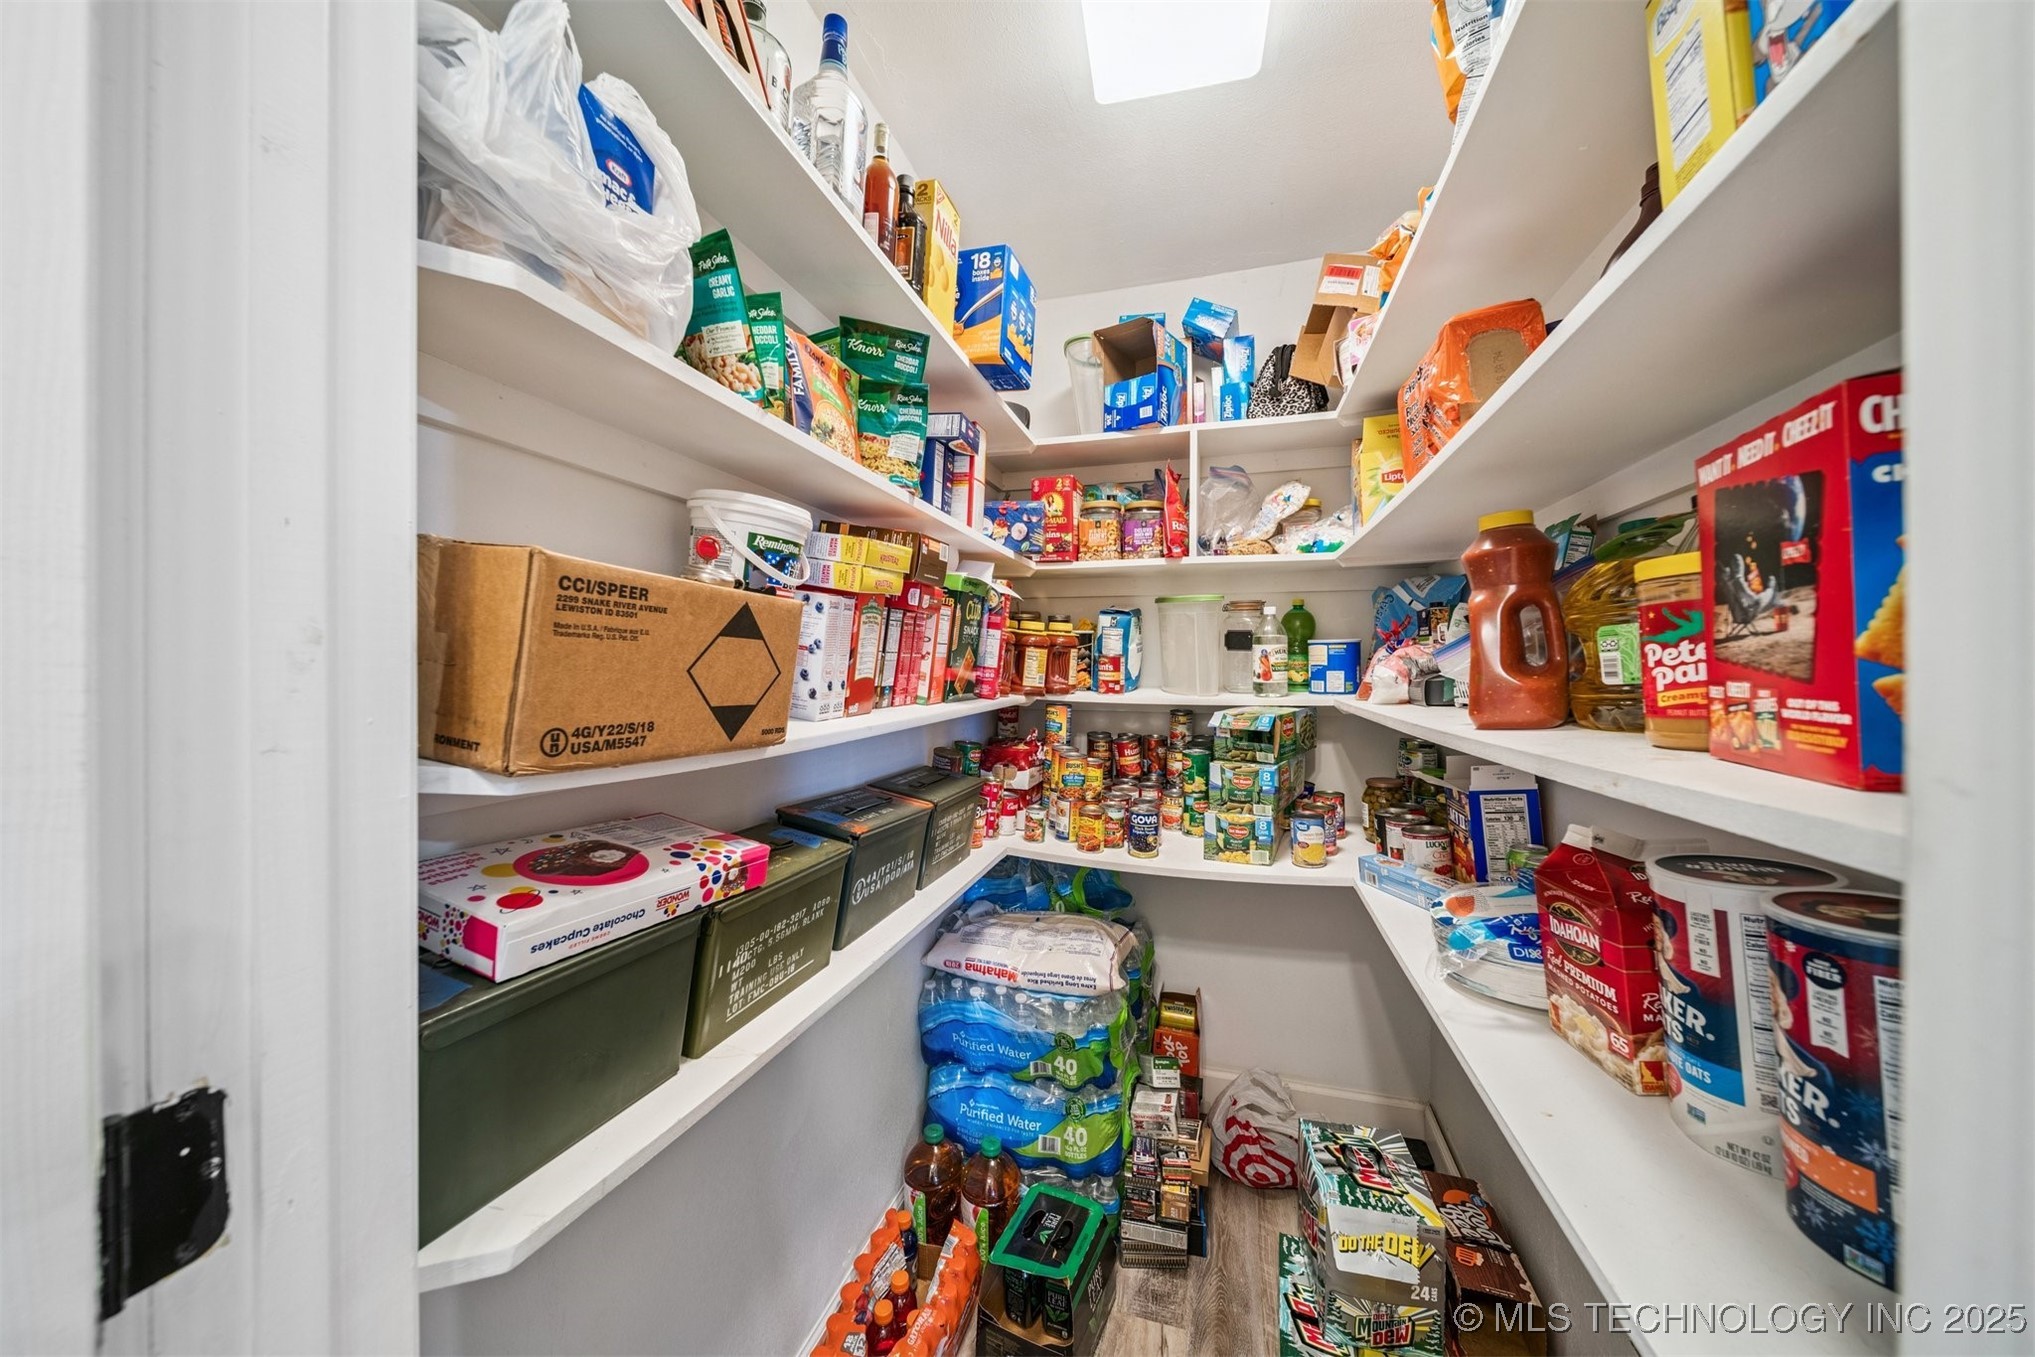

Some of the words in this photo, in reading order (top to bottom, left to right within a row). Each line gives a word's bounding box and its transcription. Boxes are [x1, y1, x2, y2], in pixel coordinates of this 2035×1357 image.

[917, 183, 929, 196] 2
[935, 210, 958, 260] Nilla
[970, 252, 991, 269] 18
[708, 274, 732, 289] CREAMY
[712, 286, 736, 300] GARLIC
[847, 338, 885, 358] Knorr
[894, 361, 918, 375] BROCCOLI
[895, 354, 920, 367] CHEDDAR
[857, 398, 888, 414] Knorr
[899, 407, 923, 416] CHEDDAR
[1158, 385, 1169, 426] Ziploc
[897, 414, 923, 423] BROCCOLI
[753, 535, 800, 555] Remington
[558, 575, 649, 601] CCI/SPEER
[555, 603, 603, 616] LEWISTON
[604, 608, 614, 617] ID
[615, 610, 638, 619] 83501
[556, 594, 579, 604] 2299
[581, 597, 611, 608] SNAKE
[612, 600, 637, 611] RIVER
[638, 604, 669, 615] AVENUE
[552, 629, 591, 639] Trademarks
[553, 621, 572, 630] Made
[963, 626, 979, 636] SNACK
[571, 721, 655, 739] 4G/Y22/S/18
[570, 736, 647, 755] USA/M5547
[1065, 762, 1084, 770] BUSH'S
[1263, 772, 1271, 782] 8
[1131, 814, 1158, 825] GOYA
[1259, 821, 1267, 831] 8
[656, 889, 690, 908] WONDER
[593, 908, 646, 932] Chocolate
[530, 927, 591, 954] Cupcakes
[736, 907, 808, 956] 1305-00-182-3217
[1549, 914, 1601, 952] IDAHOAN
[728, 969, 767, 1005] TRAINING
[770, 959, 785, 975] USE
[786, 946, 805, 966] ONLY
[730, 976, 743, 993] WT
[768, 951, 784, 968] LBS
[732, 958, 757, 982] M200
[964, 961, 1019, 983] Mahatma
[1546, 946, 1563, 968] Real
[1564, 958, 1618, 1003] PREMIUM
[1805, 965, 1843, 984] FIBER
[1039, 978, 1064, 987] Enriched
[1064, 980, 1081, 990] Long
[1082, 982, 1097, 990] Extra
[1548, 964, 1574, 989] MASHED
[1574, 980, 1619, 1015] POTATOES
[952, 1034, 995, 1053] Purified
[997, 1044, 1032, 1060] Water
[1611, 1032, 1630, 1055] 65
[1053, 1056, 1078, 1075] 40
[960, 1102, 1005, 1125] Purified
[1006, 1113, 1042, 1132] Water
[1063, 1126, 1088, 1146] 40
[1065, 1150, 1088, 1160] BOTTLES
[1726, 1141, 1740, 1152] NET
[1752, 1150, 1761, 1161] 42
[1338, 1235, 1357, 1252] DO
[1359, 1233, 1383, 1252] THE
[1383, 1231, 1436, 1268] DEW
[1411, 1286, 1430, 1302] 24
